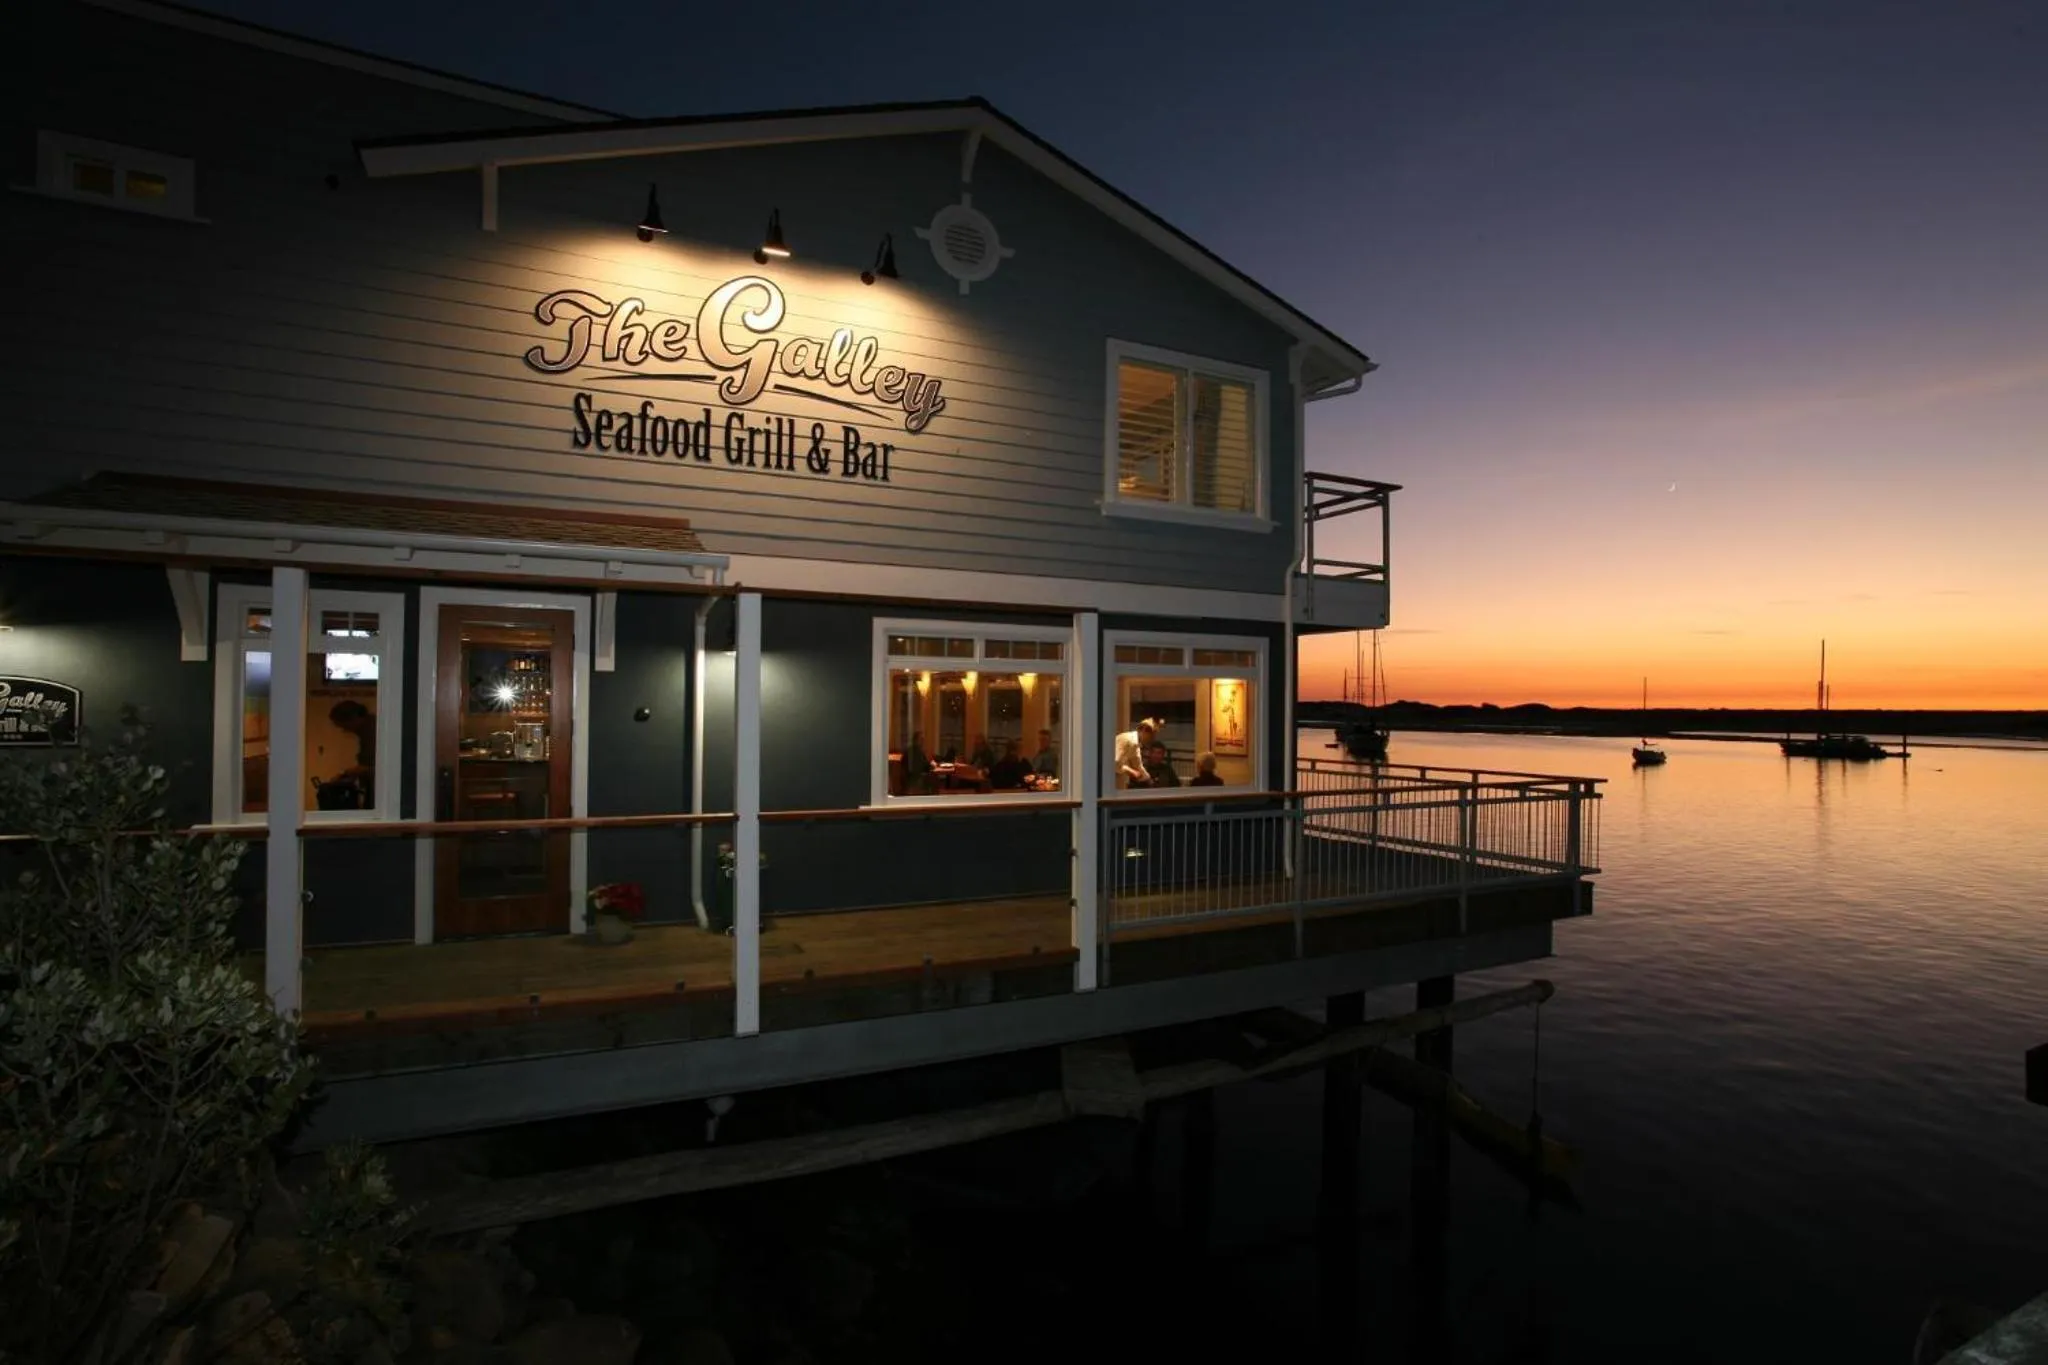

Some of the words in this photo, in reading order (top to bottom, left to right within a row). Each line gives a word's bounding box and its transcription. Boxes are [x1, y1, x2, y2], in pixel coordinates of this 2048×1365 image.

[525, 289, 690, 374] The
[697, 275, 947, 434] Galley
[572, 392, 712, 462] Seafood
[724, 410, 797, 473] Grill
[805, 423, 831, 475] &
[840, 425, 896, 483] Bar
